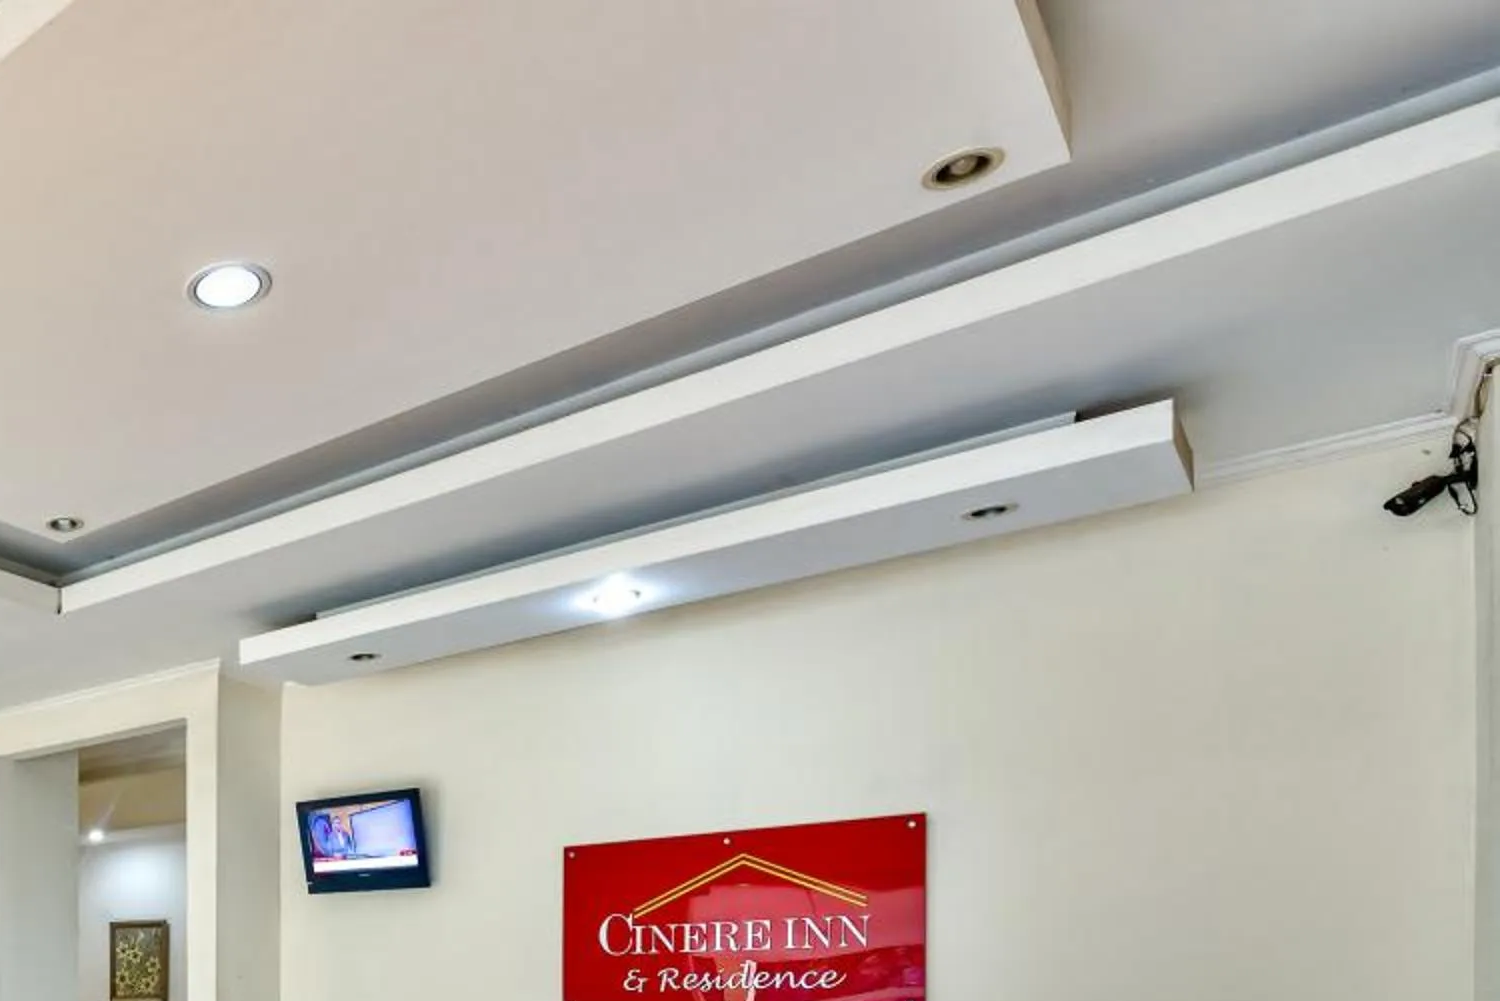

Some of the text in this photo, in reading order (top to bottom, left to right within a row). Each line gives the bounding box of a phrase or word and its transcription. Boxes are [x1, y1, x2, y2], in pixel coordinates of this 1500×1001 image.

[598, 913, 870, 956] CINERE INN
[622, 960, 848, 993] & Residence
